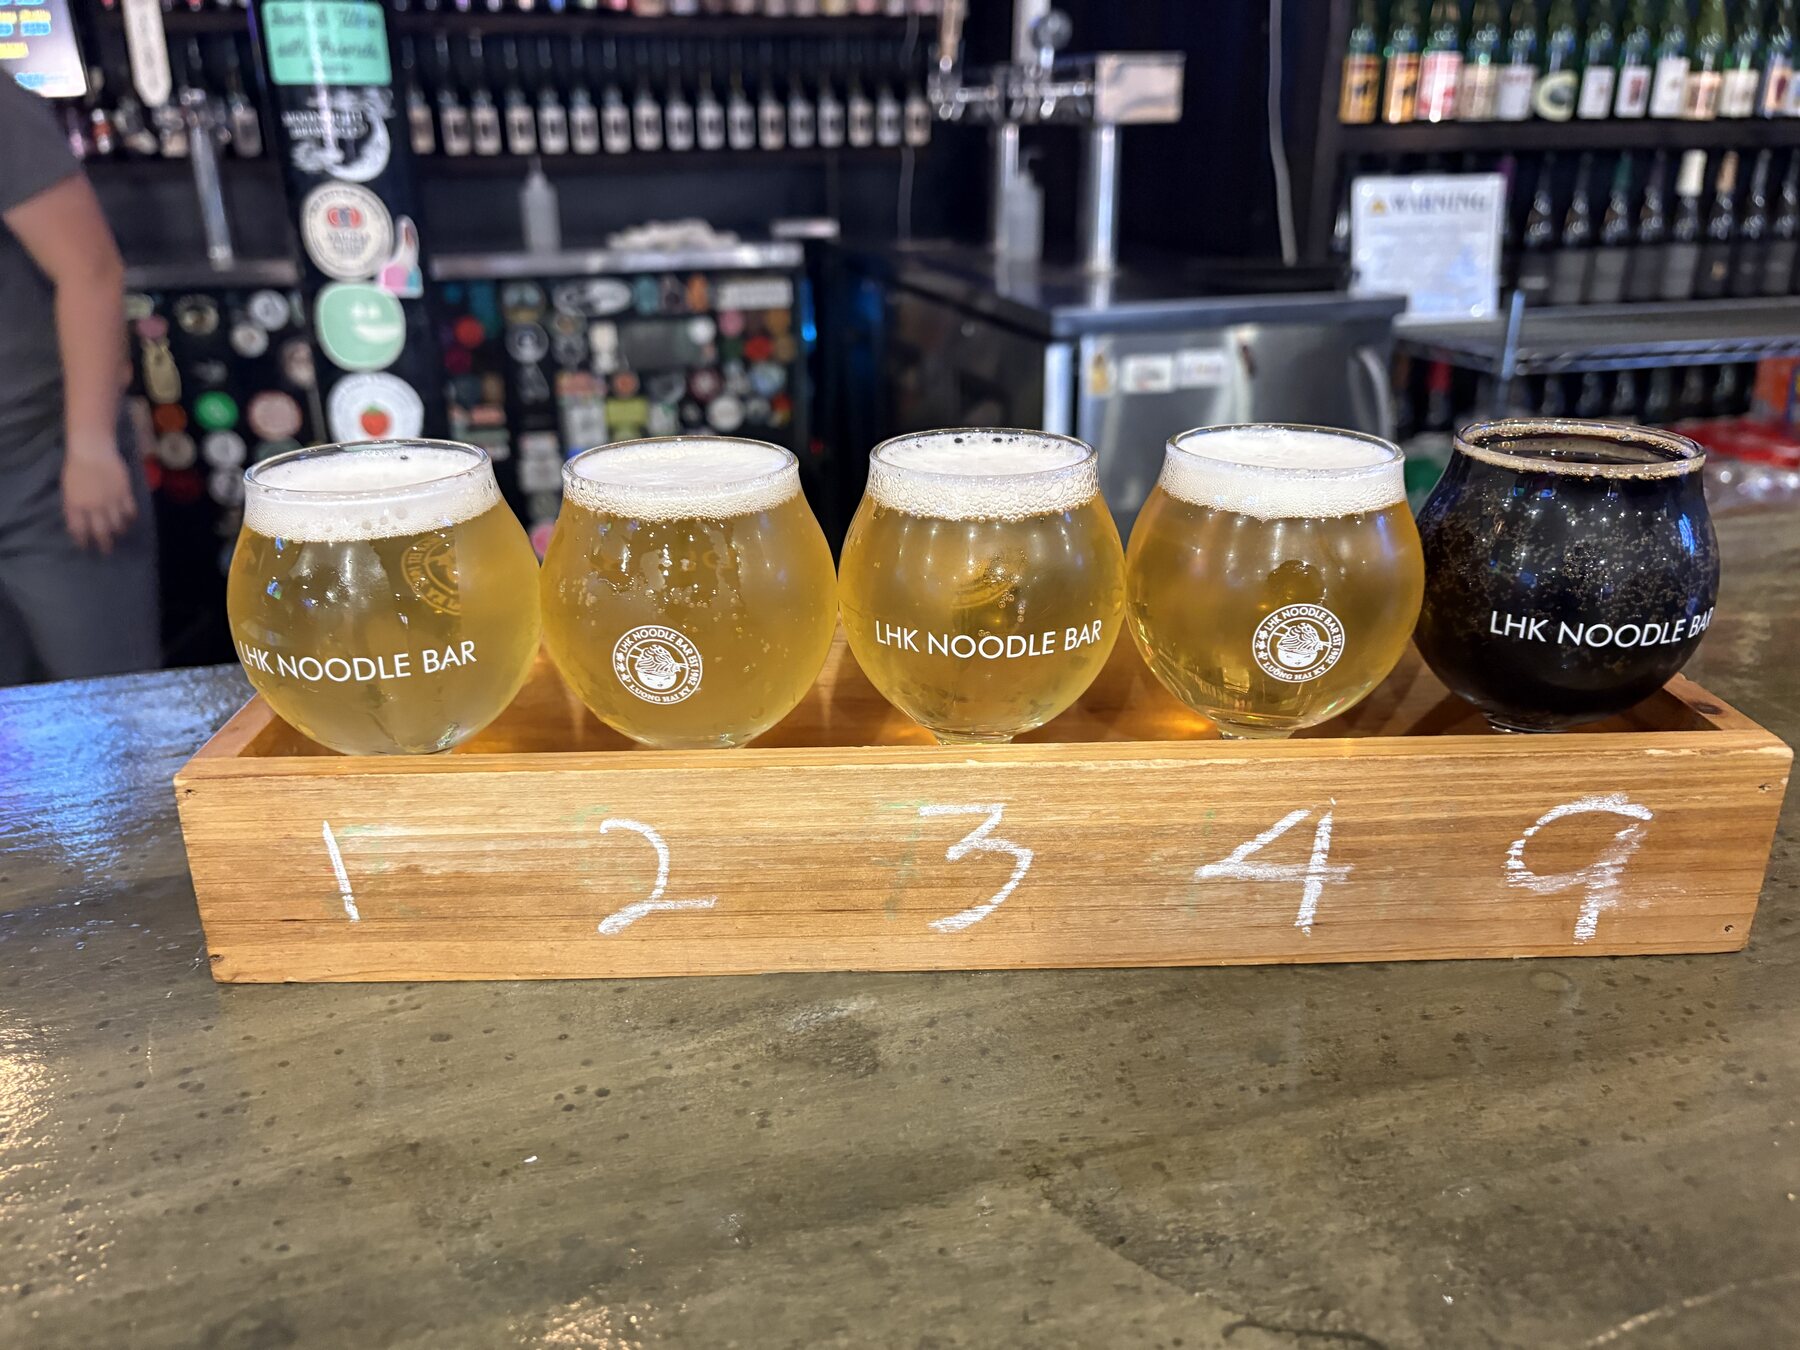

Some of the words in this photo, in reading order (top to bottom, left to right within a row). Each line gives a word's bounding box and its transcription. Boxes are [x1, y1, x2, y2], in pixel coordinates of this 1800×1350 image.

[875, 619, 920, 653] LHK
[928, 631, 1057, 659] NOODLE
[1063, 619, 1102, 652] BAR
[1264, 615, 1282, 631] LHK
[1282, 606, 1327, 620] NOODLE
[1324, 617, 1340, 635] BAR
[1489, 609, 1550, 643] LHK
[1557, 620, 1687, 648] NOODLE
[238, 639, 276, 676] LHK
[276, 653, 412, 682] NOODLE
[422, 640, 478, 674] BAR
[619, 637, 634, 653] LHK
[632, 628, 677, 642] NOODLE
[675, 638, 693, 656] BAR
[322, 820, 360, 922] 1
[597, 817, 718, 935] 2
[917, 801, 1034, 933] 3
[1193, 797, 1354, 938] 4
[1501, 791, 1655, 945] 9
